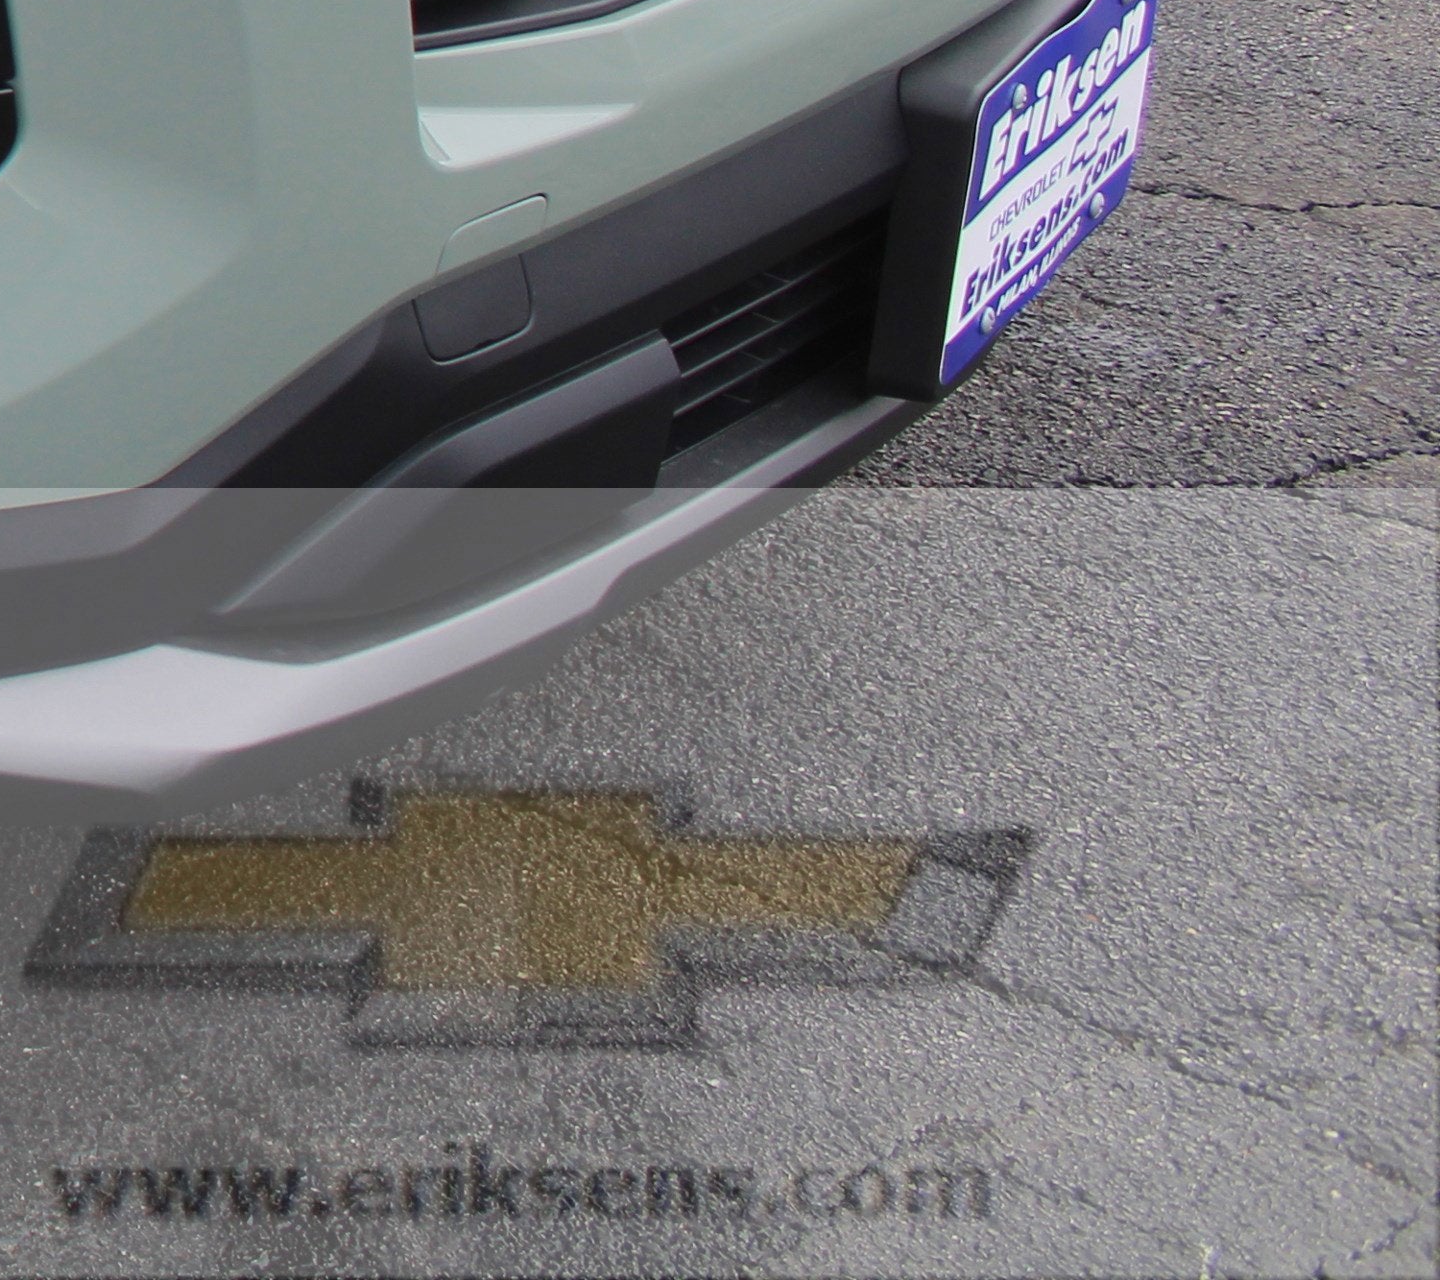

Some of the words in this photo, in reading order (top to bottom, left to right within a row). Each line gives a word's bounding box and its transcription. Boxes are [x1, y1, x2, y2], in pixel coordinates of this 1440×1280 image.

[979, 0, 1147, 202] Eriksen
[989, 155, 1067, 242] CHEVROLET
[959, 127, 1129, 323] Eriksens.com
